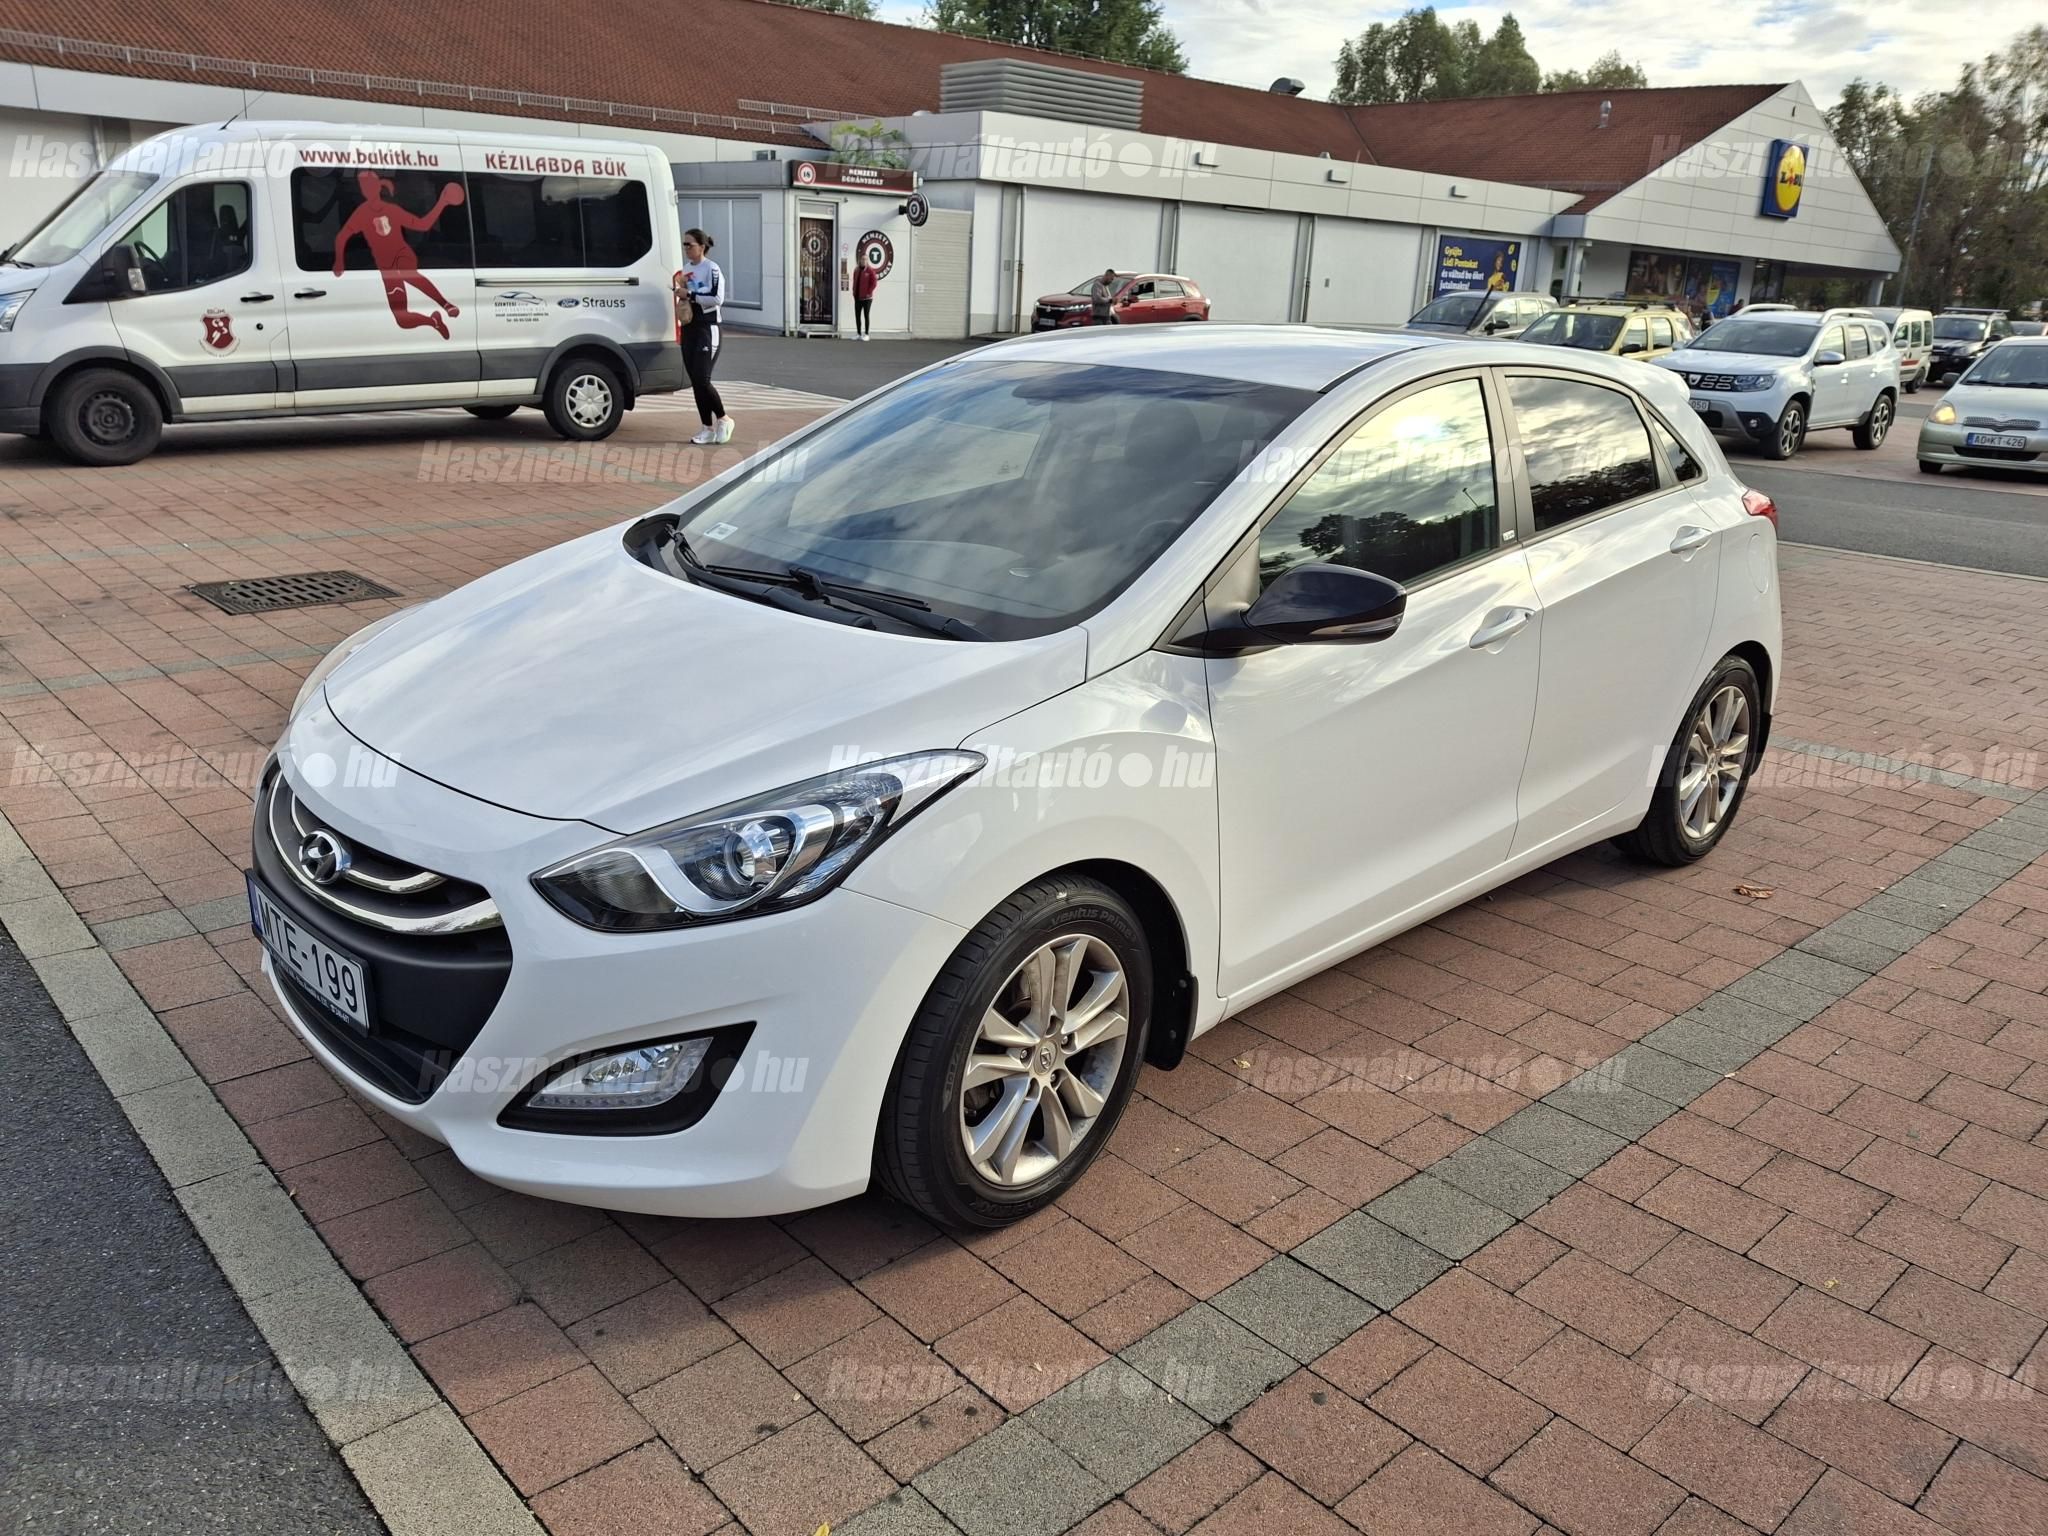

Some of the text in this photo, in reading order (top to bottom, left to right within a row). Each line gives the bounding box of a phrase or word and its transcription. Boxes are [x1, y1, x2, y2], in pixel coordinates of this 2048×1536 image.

[300, 147, 439, 167] www.bukitk.hu
[485, 150, 628, 177] KÉZILABDA BÜK
[582, 297, 626, 308] Strauss
[258, 893, 358, 1013] MTE-199
